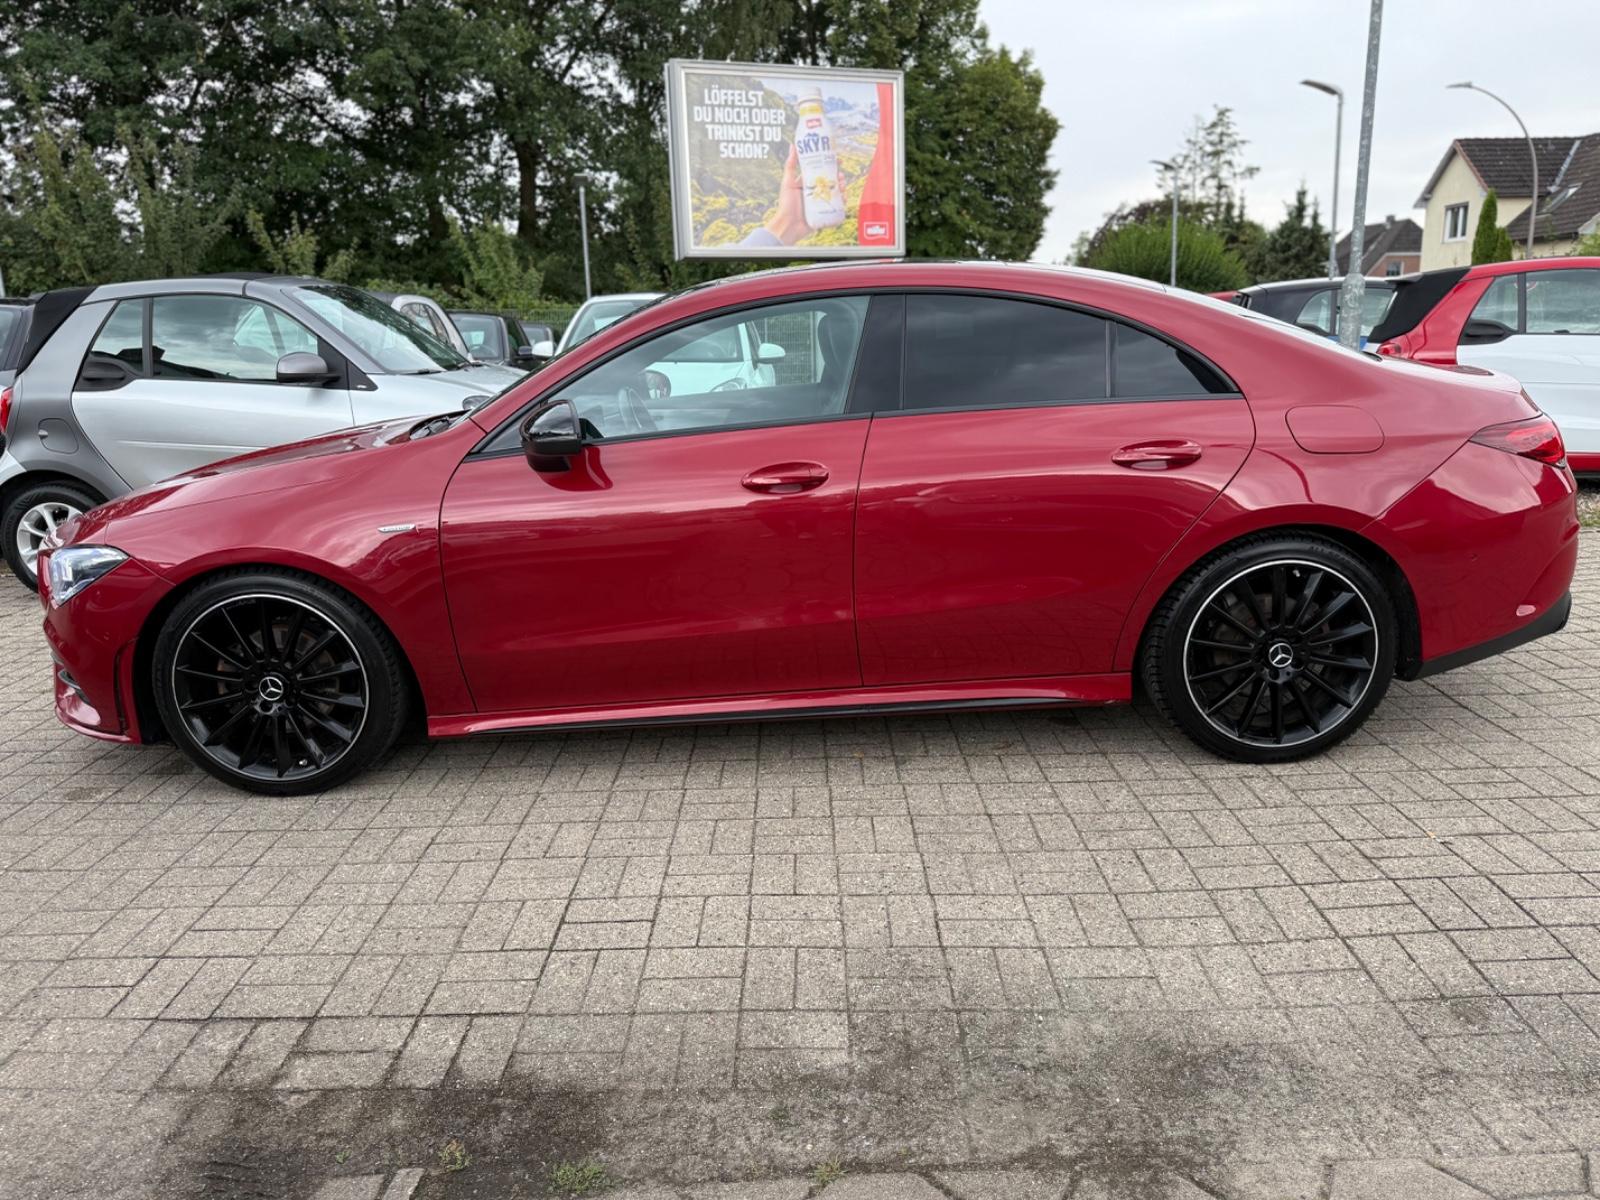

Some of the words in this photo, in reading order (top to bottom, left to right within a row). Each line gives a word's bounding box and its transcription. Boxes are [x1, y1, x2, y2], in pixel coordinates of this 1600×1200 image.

[704, 84, 764, 107] LÖFFELST
[693, 106, 713, 122] DU
[714, 107, 750, 124] NOCH
[751, 108, 786, 125] ODER
[705, 124, 762, 142] TRINKST
[763, 126, 782, 142] DU
[719, 142, 770, 159] SCHON?
[797, 136, 830, 154] SKYR
